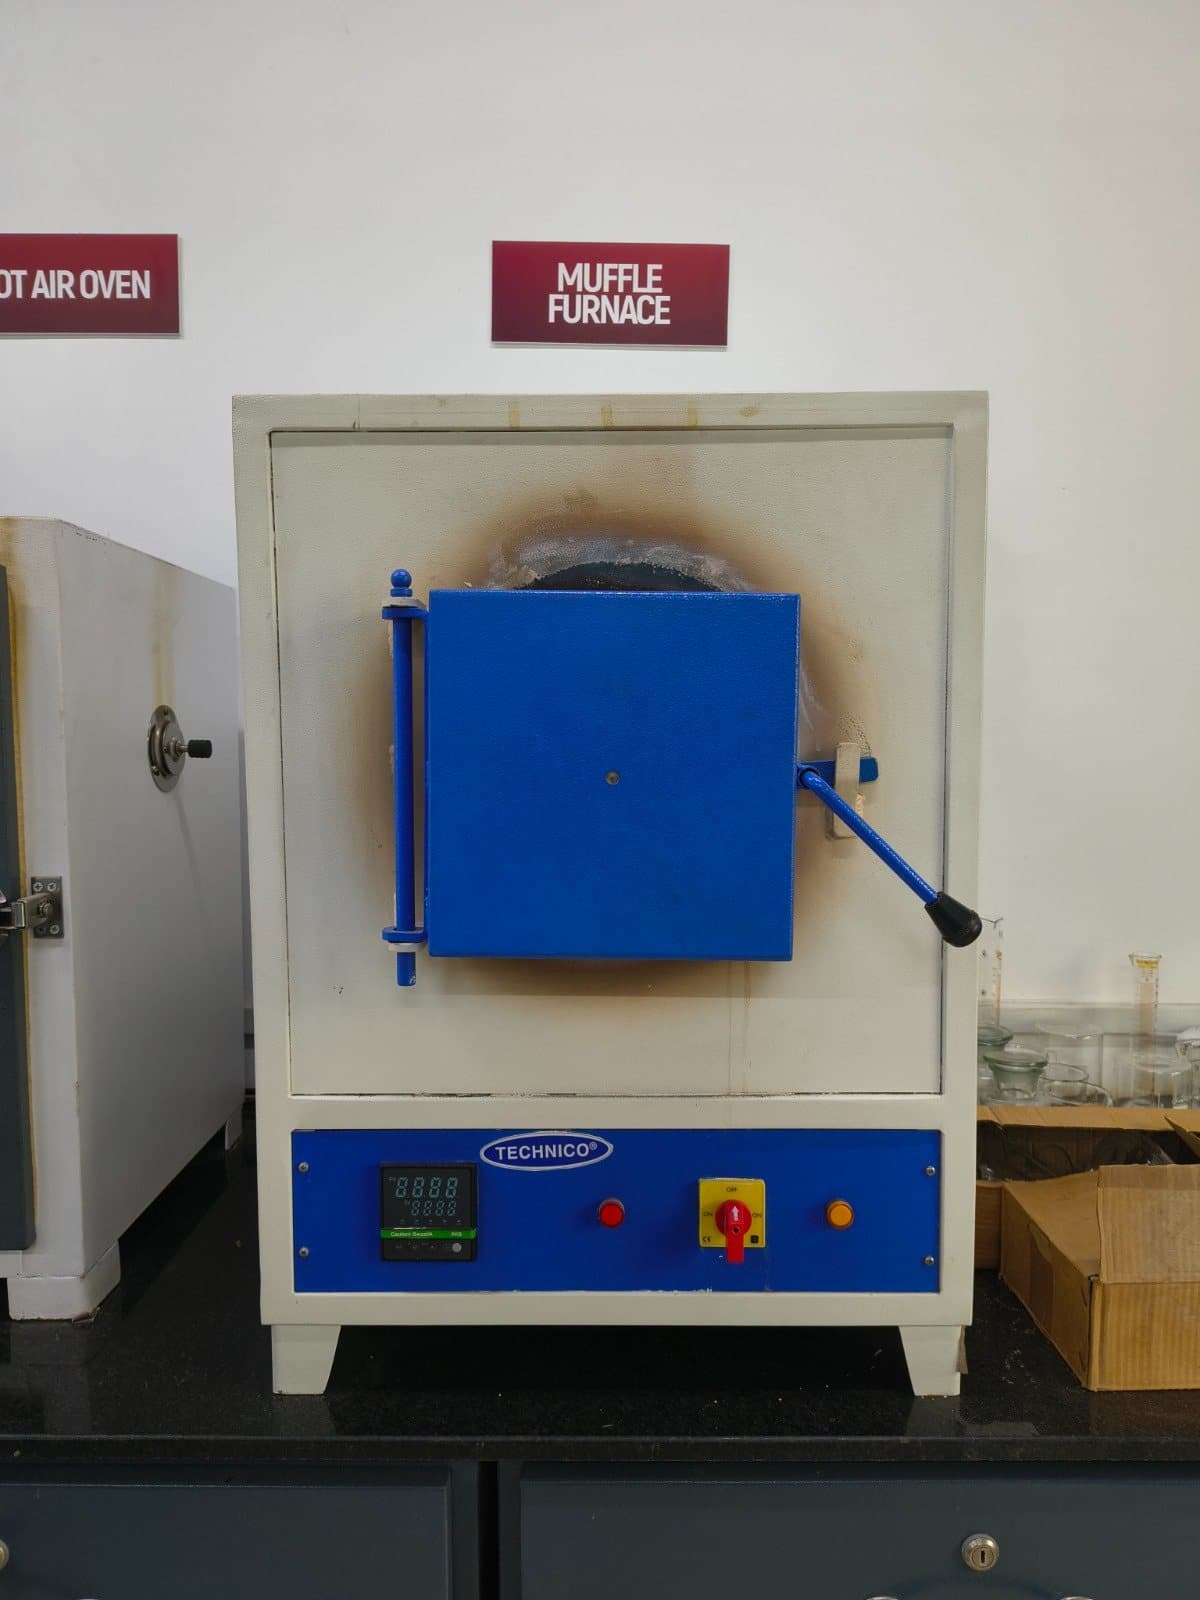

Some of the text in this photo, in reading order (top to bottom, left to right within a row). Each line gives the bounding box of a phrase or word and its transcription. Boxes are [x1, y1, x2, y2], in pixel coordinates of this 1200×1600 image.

[31, 269, 75, 299] AIR
[79, 269, 151, 299] OVEN
[557, 262, 663, 293] MUFFLE
[548, 294, 671, 325] FURNACE
